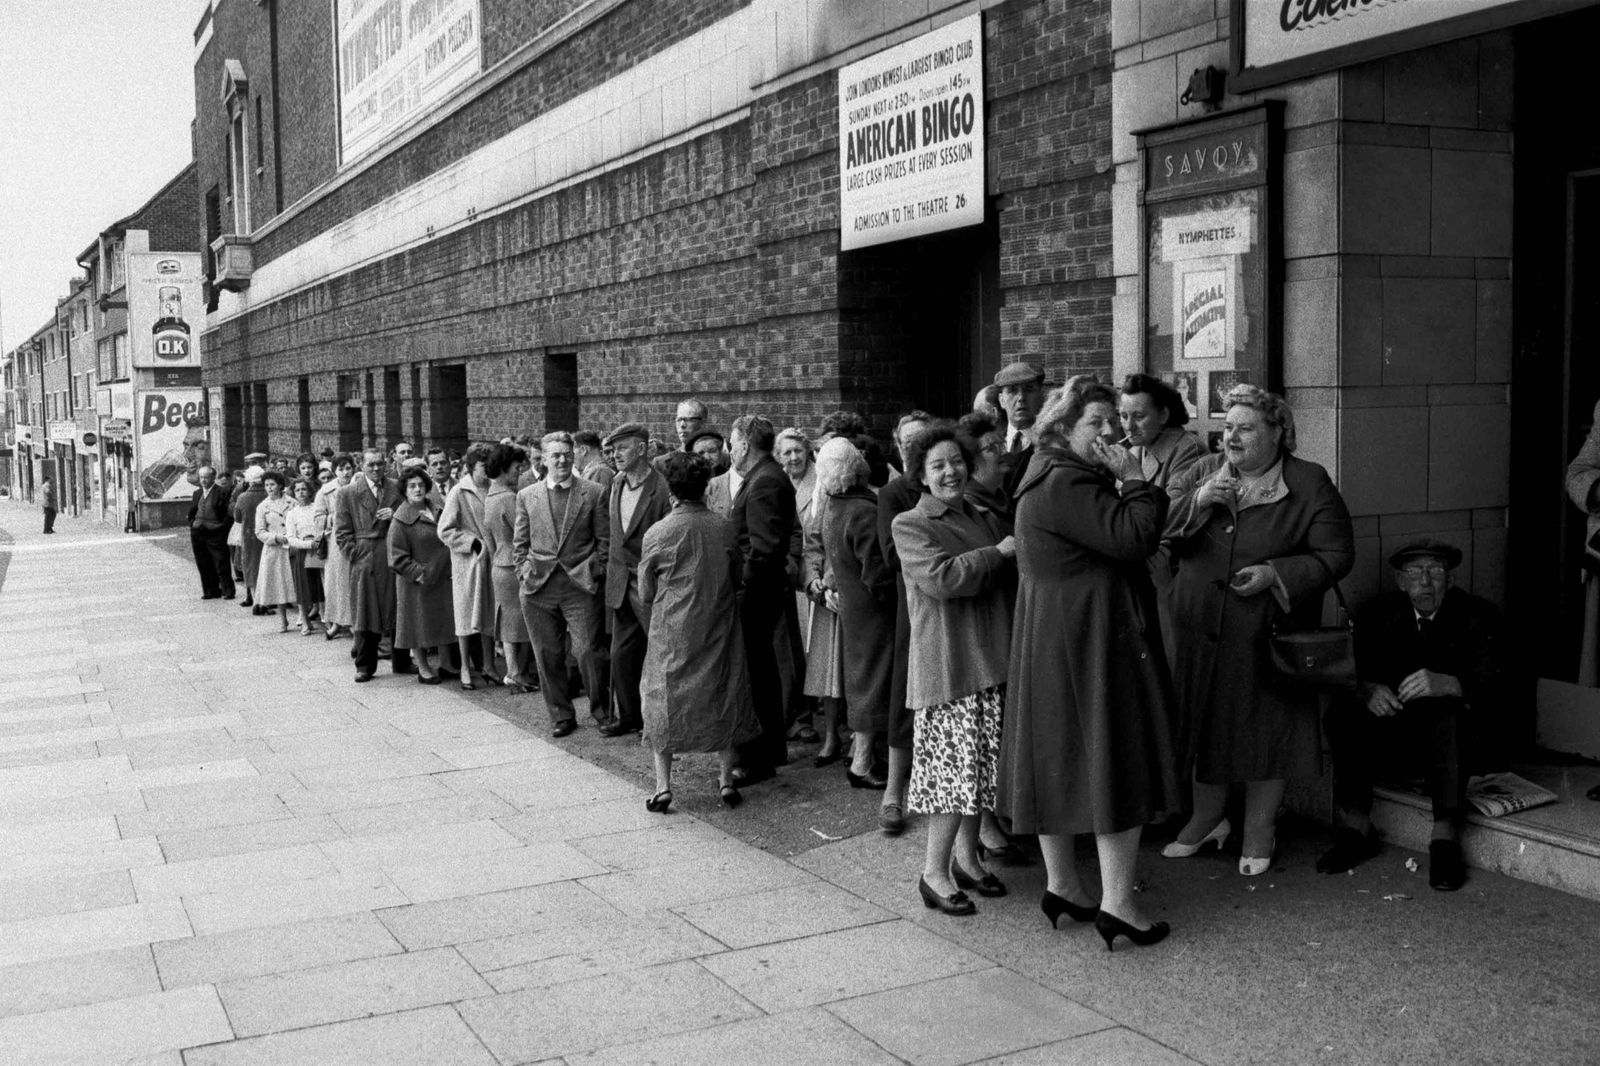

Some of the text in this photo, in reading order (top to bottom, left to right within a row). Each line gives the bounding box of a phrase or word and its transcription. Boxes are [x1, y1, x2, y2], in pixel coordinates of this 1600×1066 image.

[846, 82, 858, 102] JOIN
[883, 65, 903, 89] NEWEST
[908, 54, 932, 80] LARGEST
[934, 46, 954, 70] BINGO
[956, 39, 973, 63] CLUB
[849, 105, 871, 125] SUNDAY
[873, 98, 887, 118] NEXT
[846, 92, 975, 170] AMERICAN BINGO
[847, 141, 973, 192] LARGE CASH PRIZES AT EVERY SESSION
[1164, 140, 1243, 177] SAVOY
[854, 210, 889, 233] ADMISSION
[892, 207, 901, 224] TO
[903, 204, 915, 222] THE
[917, 196, 948, 219] THEATRE
[1178, 226, 1236, 245] NYMPHETTES
